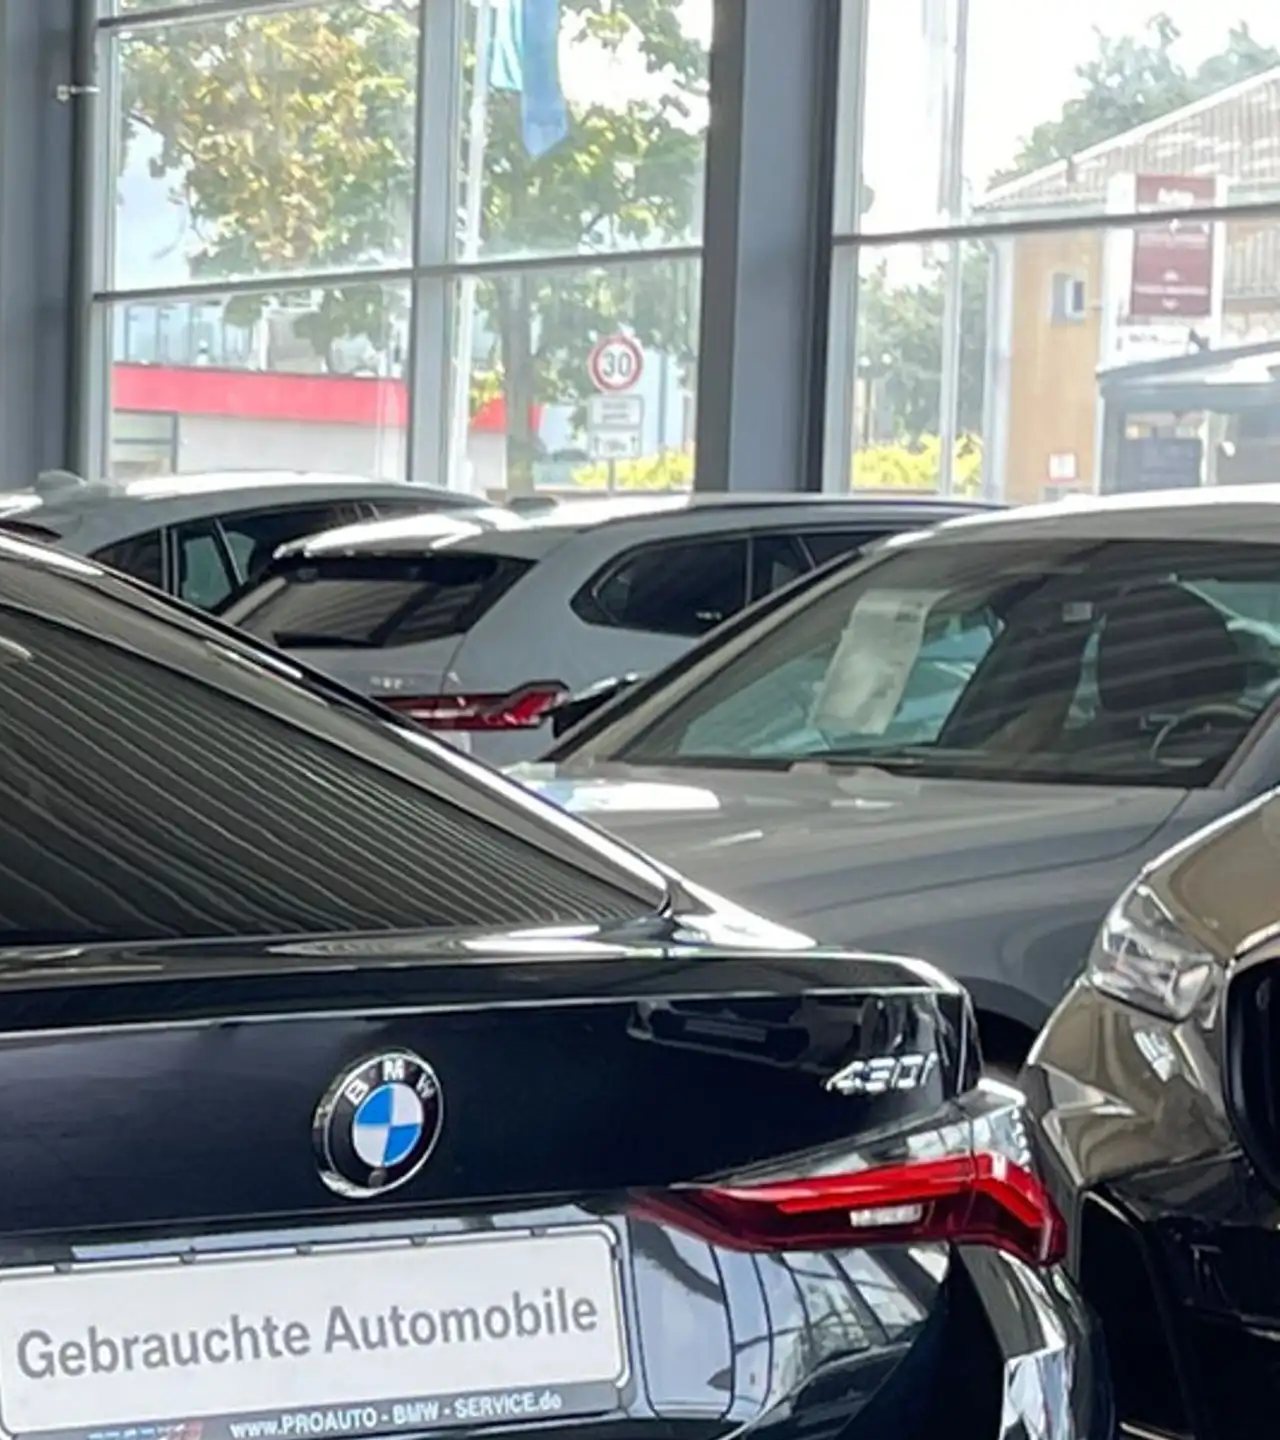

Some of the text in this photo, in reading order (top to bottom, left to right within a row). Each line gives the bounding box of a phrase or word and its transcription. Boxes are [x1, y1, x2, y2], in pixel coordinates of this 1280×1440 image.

[602, 351, 632, 378] 30
[344, 1058, 437, 1106] BMW
[16, 1288, 598, 1381] Gebrauchte Automobile
